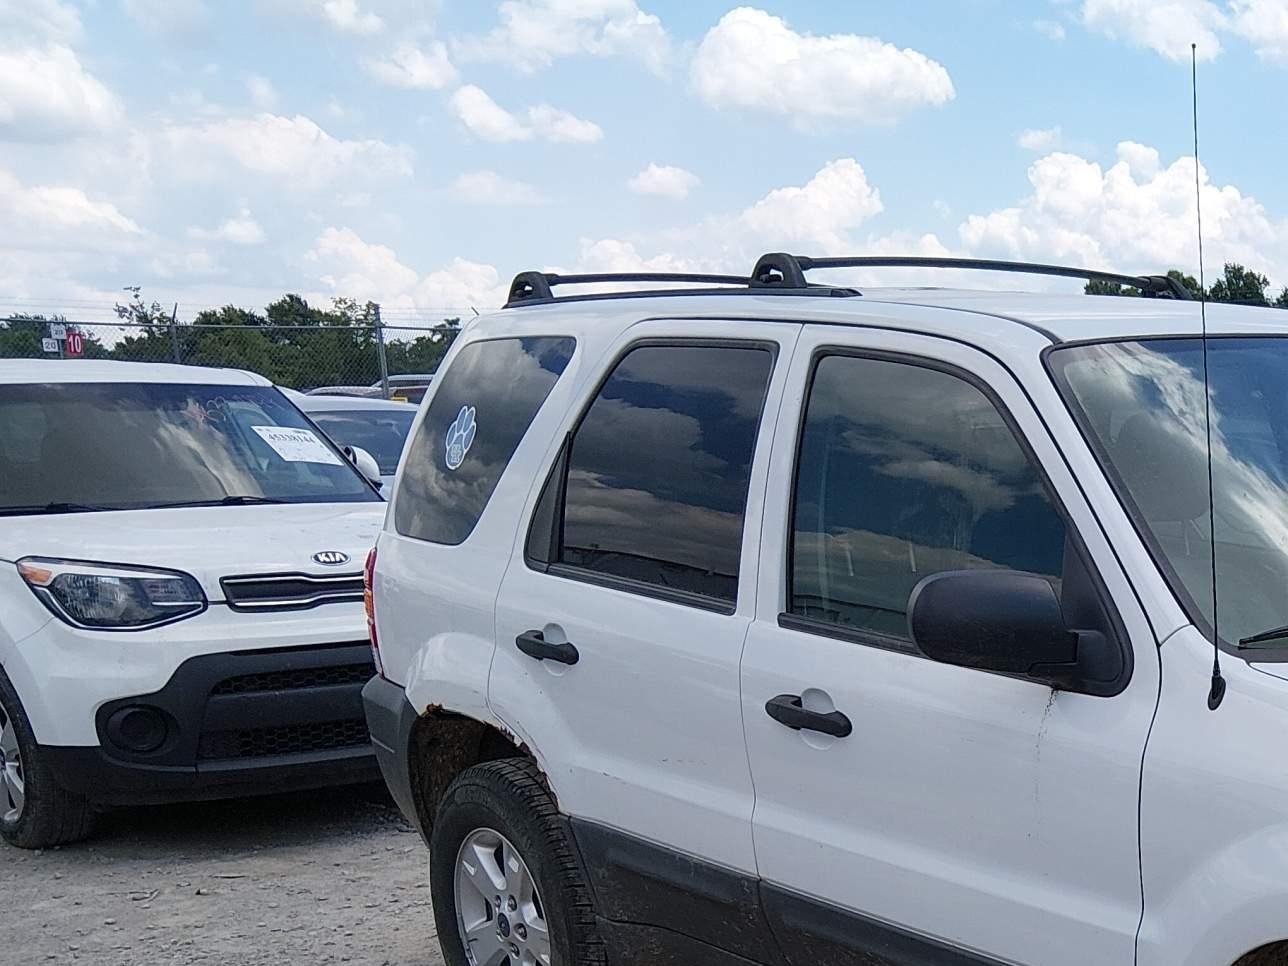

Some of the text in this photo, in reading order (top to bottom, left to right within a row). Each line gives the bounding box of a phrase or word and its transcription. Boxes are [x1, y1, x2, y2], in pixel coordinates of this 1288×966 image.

[44, 341, 57, 350] 20
[68, 334, 82, 353] 10
[316, 552, 346, 562] KIA
